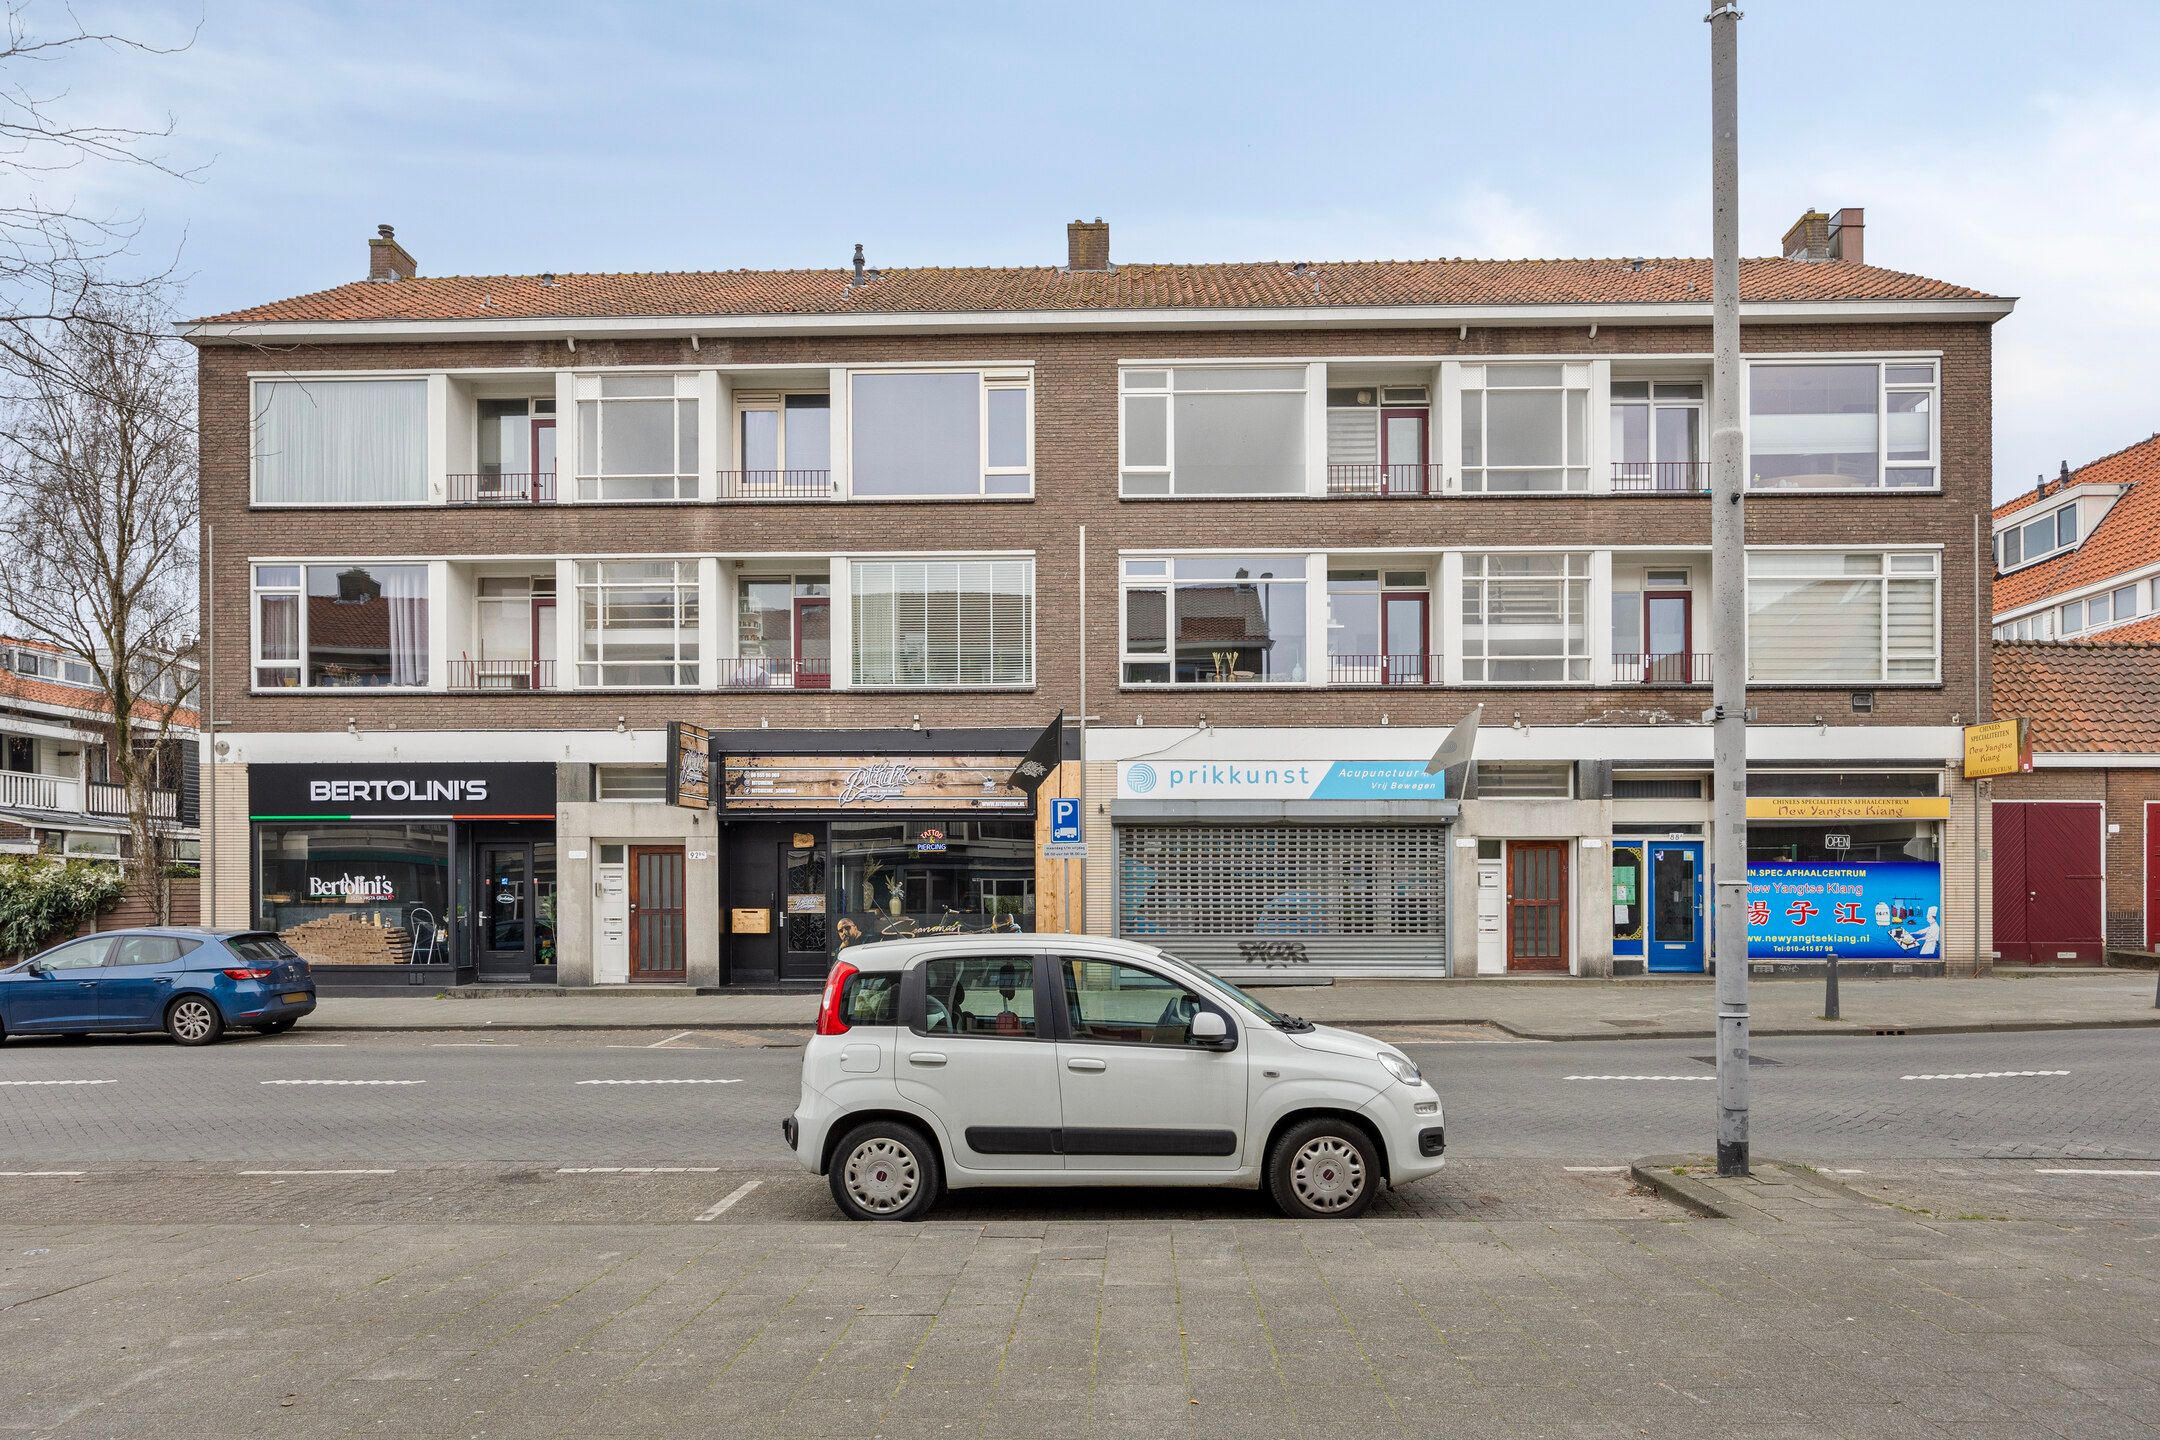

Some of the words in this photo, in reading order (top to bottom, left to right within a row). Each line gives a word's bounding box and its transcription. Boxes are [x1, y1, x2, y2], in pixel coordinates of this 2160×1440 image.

[1979, 724, 2000, 733] CHINEES
[1970, 729, 2010, 742] SPECIALITEITEN
[1969, 746, 1984, 755] New
[1985, 742, 2012, 752] Yangtse
[1980, 754, 2001, 763] Kiang
[1338, 768, 1419, 778] Acupunctuur
[1969, 765, 2012, 776] AFHAALCENTRUM
[1170, 765, 1309, 788] prikkunst
[310, 780, 487, 801] BERTOLINI'S
[1371, 782, 1386, 791] Vrij
[1390, 782, 1436, 791] Bewegen
[1057, 802, 1073, 824] P
[1778, 805, 1806, 816] New
[1811, 805, 1861, 818] Yangtse
[1865, 805, 1904, 818] Kiang
[920, 829, 944, 839] TATTOO
[1827, 836, 1850, 847] OPEN
[1747, 869, 1867, 878] IN.SPEC.AFHAALCENTRUM
[309, 872, 393, 895] Bertolini's
[1773, 882, 1824, 895] Yangtse
[1826, 882, 1863, 896] Kiang
[1747, 934, 1870, 945] ww.newyangtsekiang.nl
